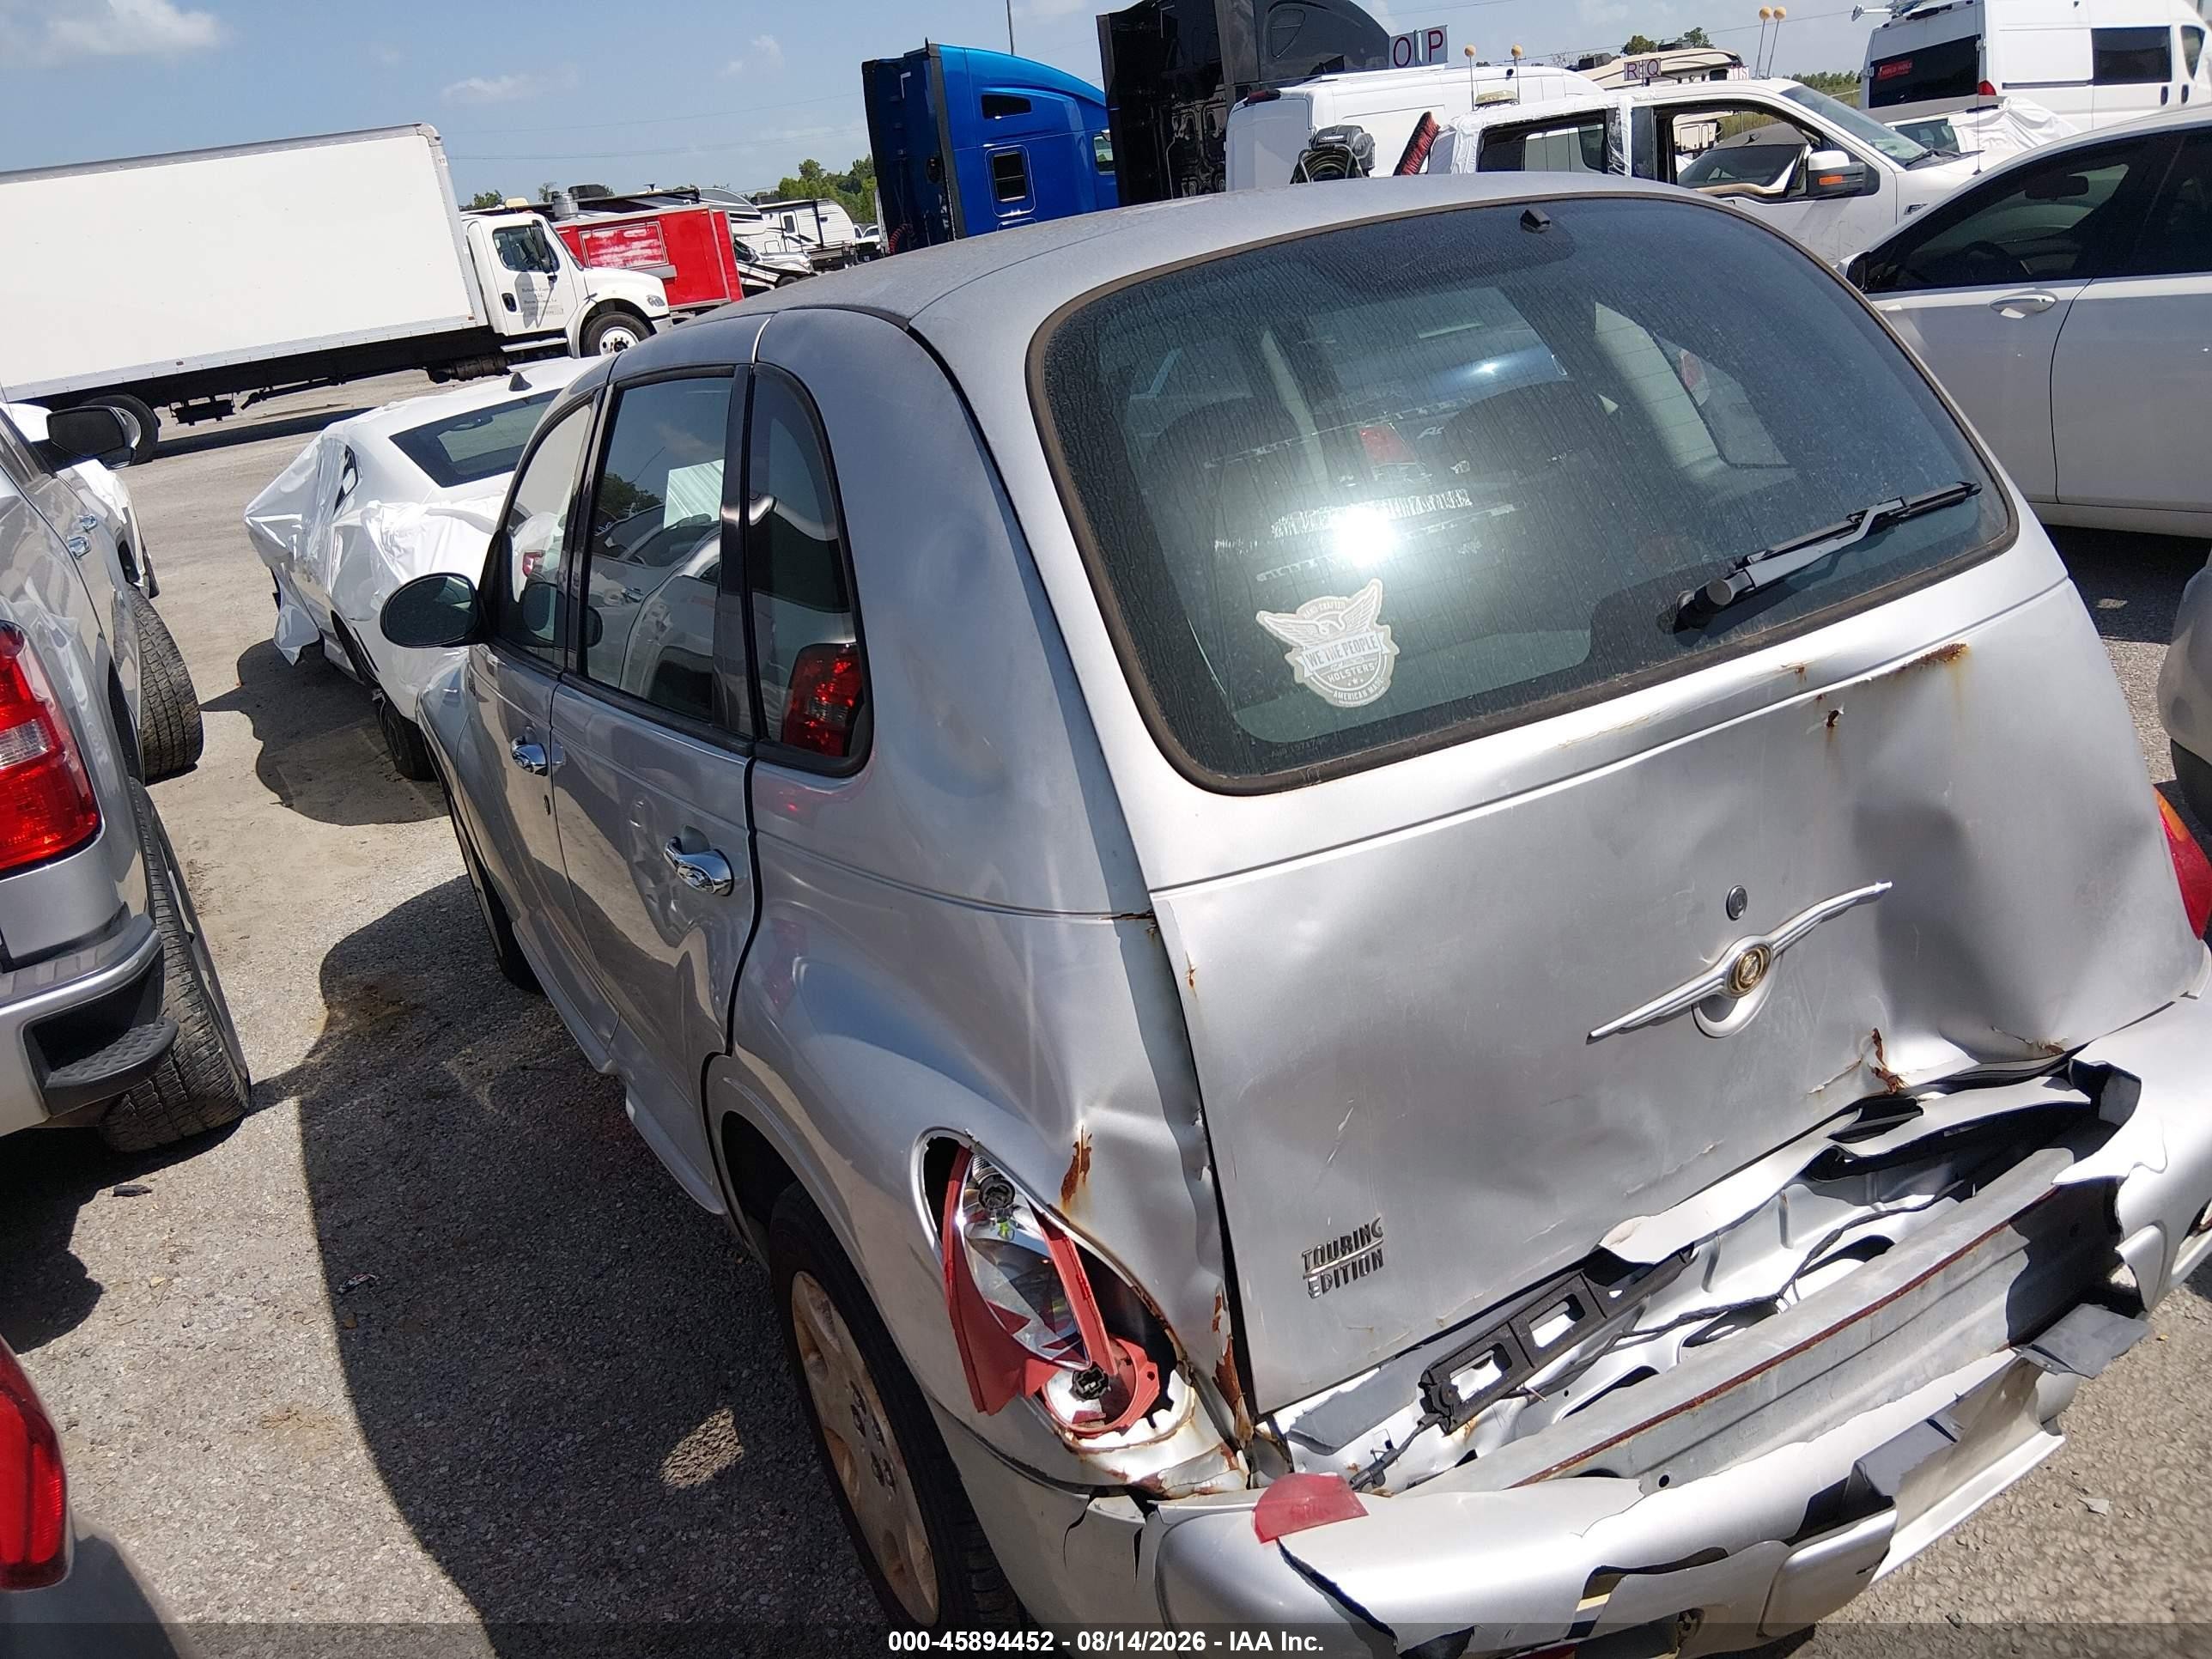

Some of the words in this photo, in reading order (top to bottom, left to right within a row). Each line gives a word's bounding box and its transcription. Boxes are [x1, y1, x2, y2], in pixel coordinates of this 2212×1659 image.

[1393, 36, 1412, 68] O
[1427, 29, 1443, 63] P
[1626, 63, 1638, 81] R
[1647, 59, 1660, 77] Q
[1305, 650, 1324, 667] WE
[1323, 643, 1343, 662] THE
[1341, 635, 1378, 656] PEOPLE
[1327, 662, 1375, 683] HOLSTERS
[1334, 689, 1367, 702] AMERICAN
[1301, 1214, 1384, 1272] TOURING
[1307, 1247, 1384, 1299] EDITION
